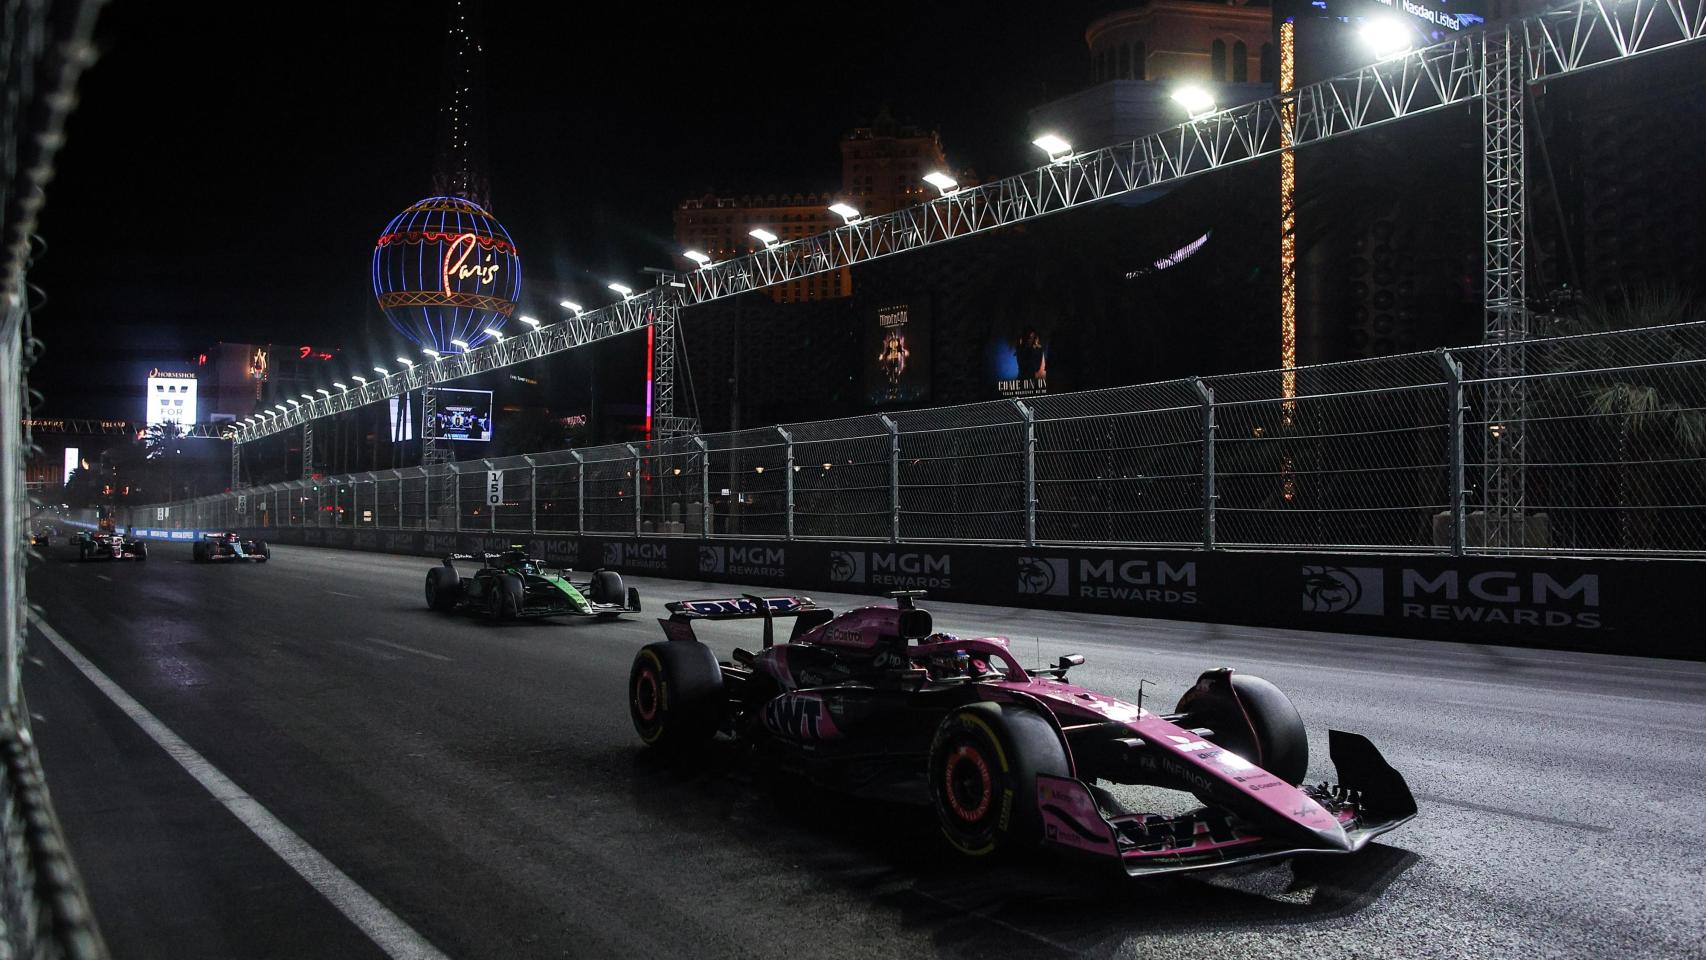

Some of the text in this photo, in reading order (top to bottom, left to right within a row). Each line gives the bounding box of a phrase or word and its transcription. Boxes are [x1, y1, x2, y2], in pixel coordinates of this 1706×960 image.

[1403, 0, 1459, 31] Nasdaq Listed
[444, 233, 499, 297] Paris
[161, 408, 182, 416] FOR
[490, 472, 499, 504] 150
[547, 540, 578, 554] MGM
[625, 543, 667, 560] MGM
[729, 546, 785, 566] MGM
[625, 559, 668, 569] REWARDS
[729, 565, 785, 577] REWARDS
[872, 552, 950, 576] MGM
[1079, 558, 1197, 587] MGM
[872, 574, 951, 589] REWARDS
[1401, 567, 1599, 608] MGM
[1079, 585, 1199, 605] REWARDS
[1402, 602, 1602, 630] REWARDS
[833, 628, 865, 641] Castrol
[1162, 756, 1213, 792] INFINOX
